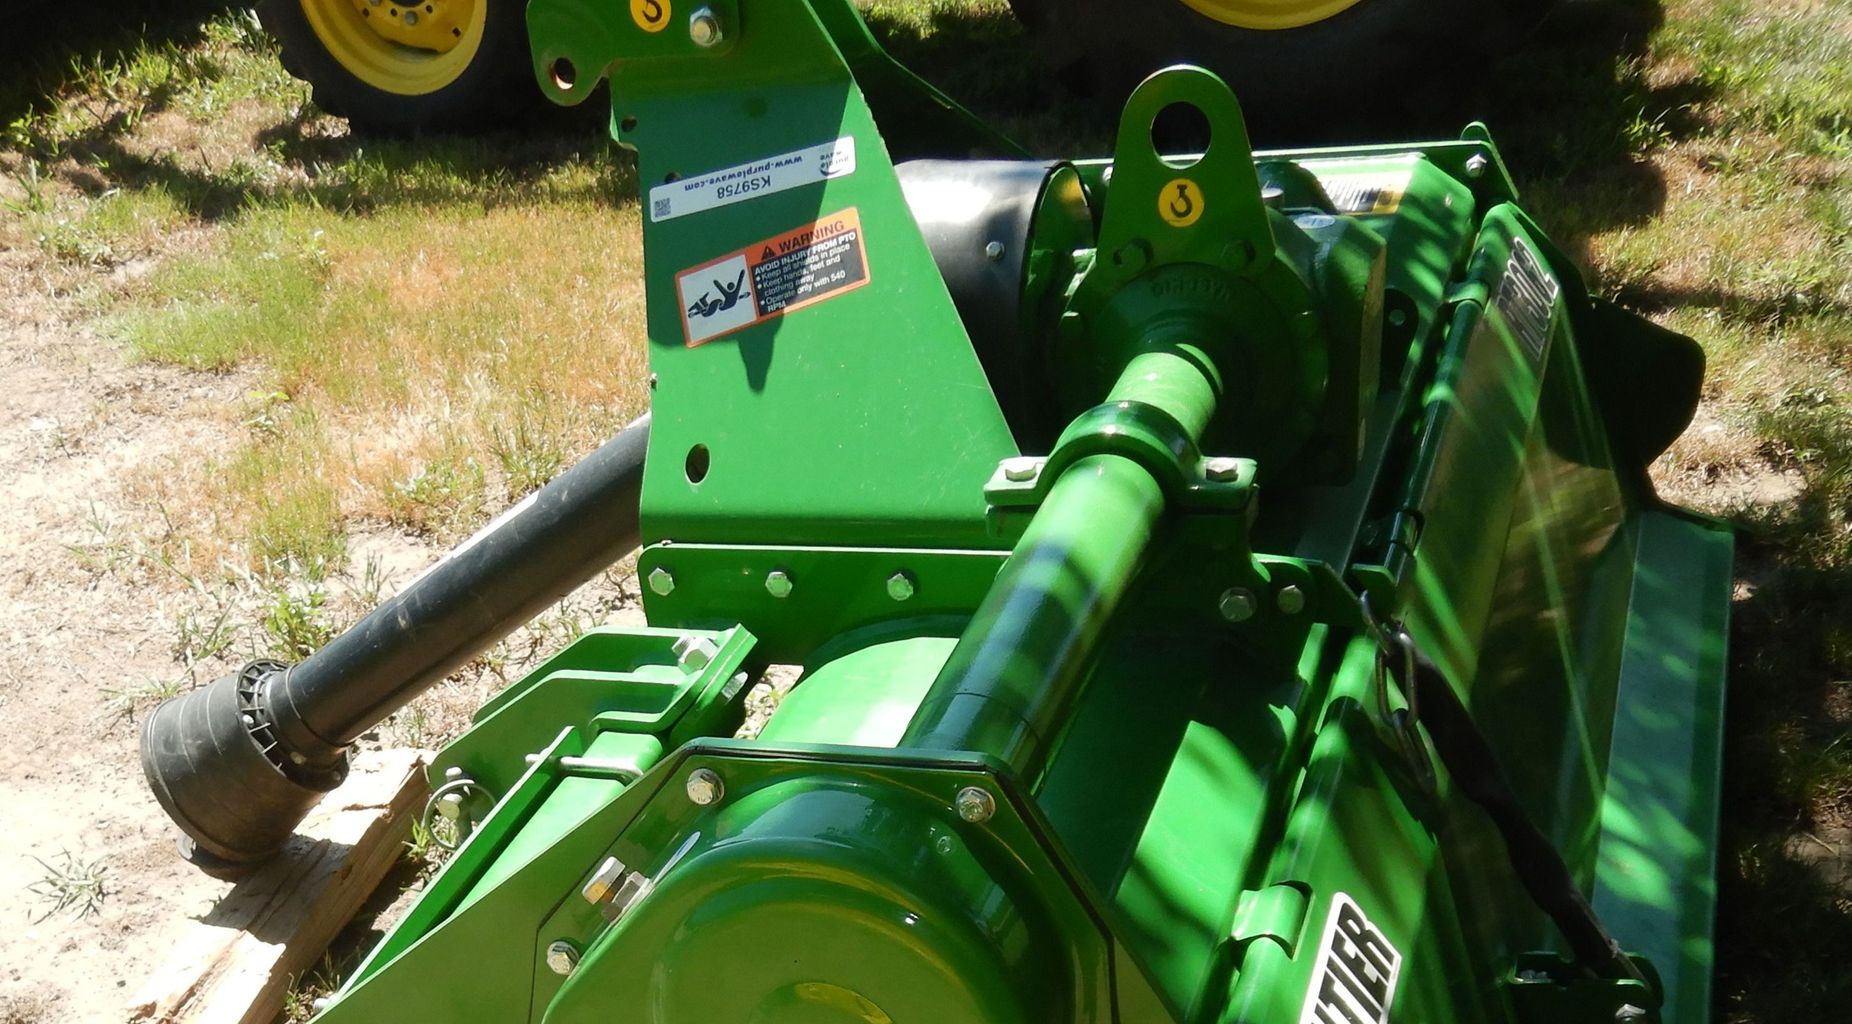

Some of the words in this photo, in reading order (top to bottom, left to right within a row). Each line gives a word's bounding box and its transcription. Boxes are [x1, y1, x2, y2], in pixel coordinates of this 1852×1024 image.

[684, 155, 803, 192] www.purplewave.com
[717, 175, 771, 200] KS9758
[779, 220, 845, 252] WARNING
[755, 260, 780, 275] AVOID
[781, 247, 810, 266] INJURY
[812, 240, 838, 254] FROM
[838, 232, 856, 246] PTO
[762, 268, 781, 281] Keep
[792, 254, 820, 270] shields
[820, 251, 829, 259] in
[829, 243, 850, 257] place
[763, 276, 783, 288] Keep
[810, 261, 825, 271] feet
[826, 255, 841, 266] and
[764, 281, 793, 297] clothing
[795, 274, 815, 286] away
[766, 289, 796, 304] Operate
[797, 282, 813, 295] only
[814, 276, 830, 288] with
[830, 270, 846, 282] 540
[767, 300, 787, 312] RPM
